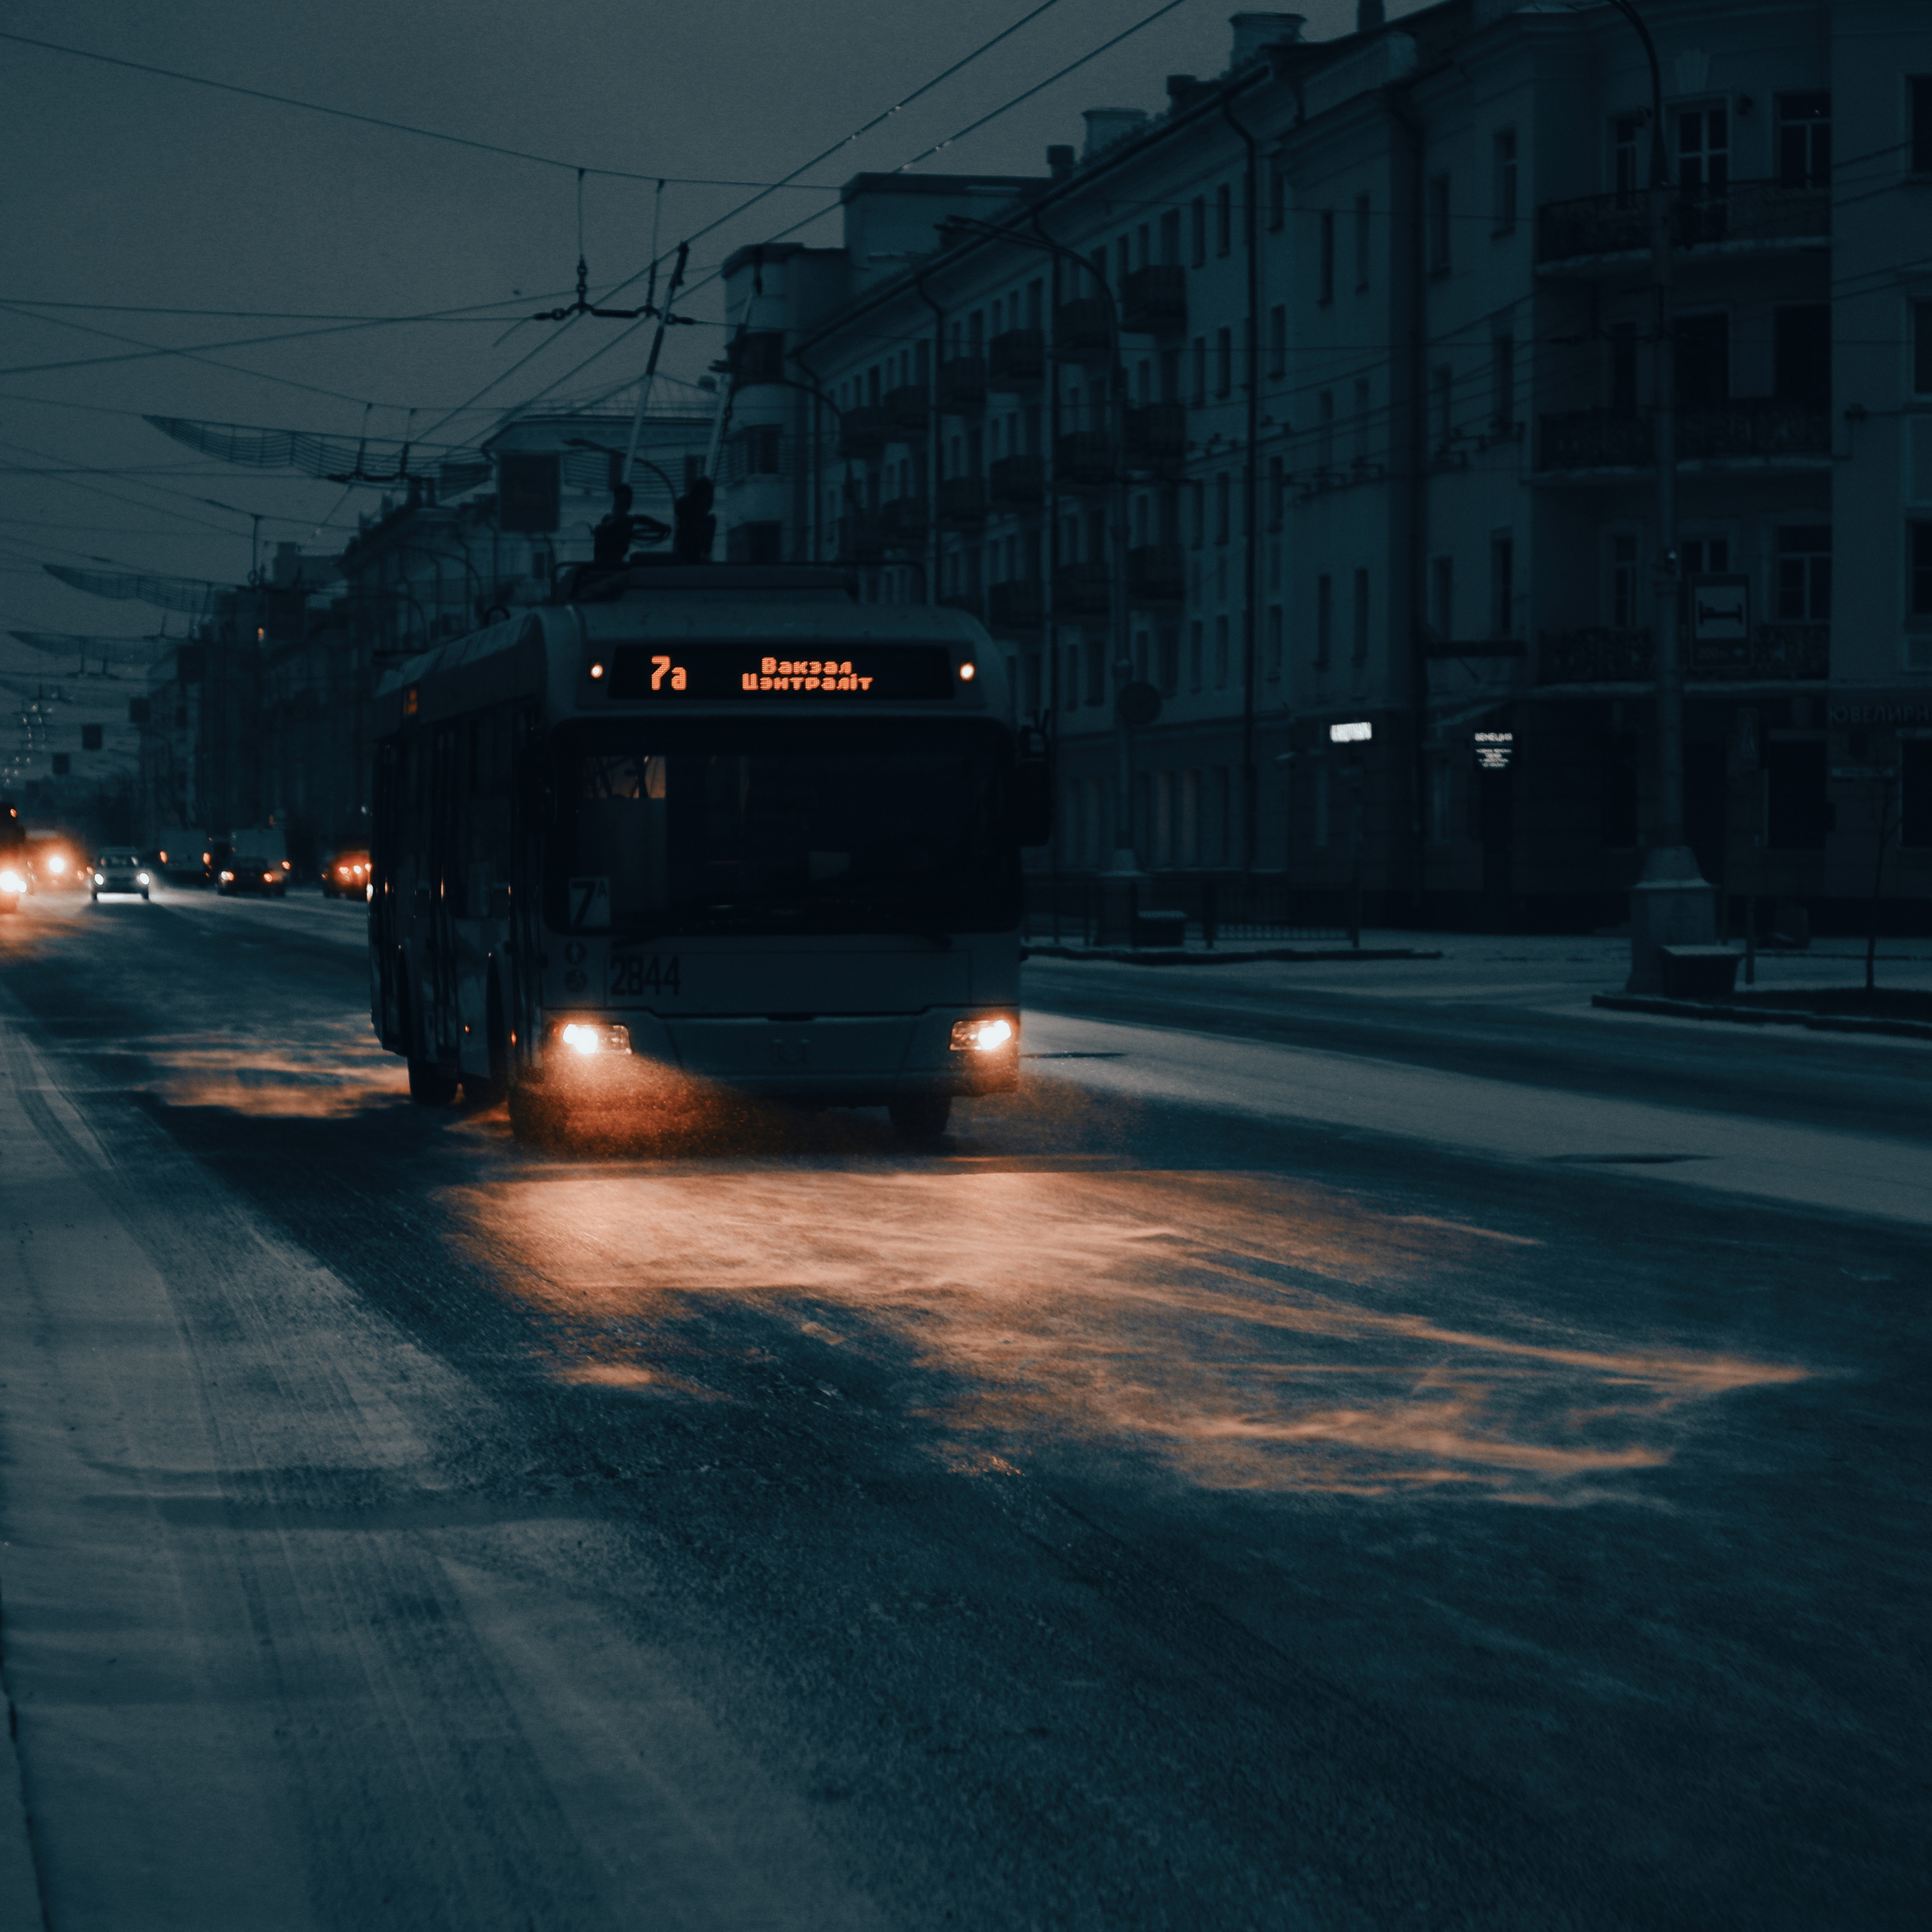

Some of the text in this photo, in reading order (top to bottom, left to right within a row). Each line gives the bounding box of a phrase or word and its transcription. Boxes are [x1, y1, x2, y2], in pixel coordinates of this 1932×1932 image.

[651, 655, 687, 691] 7а
[761, 657, 853, 675] Вакзал
[741, 672, 873, 691] Цэнтраліт
[1828, 705, 1932, 723] ЮВЕЛИРН
[611, 955, 681, 995] 2844
